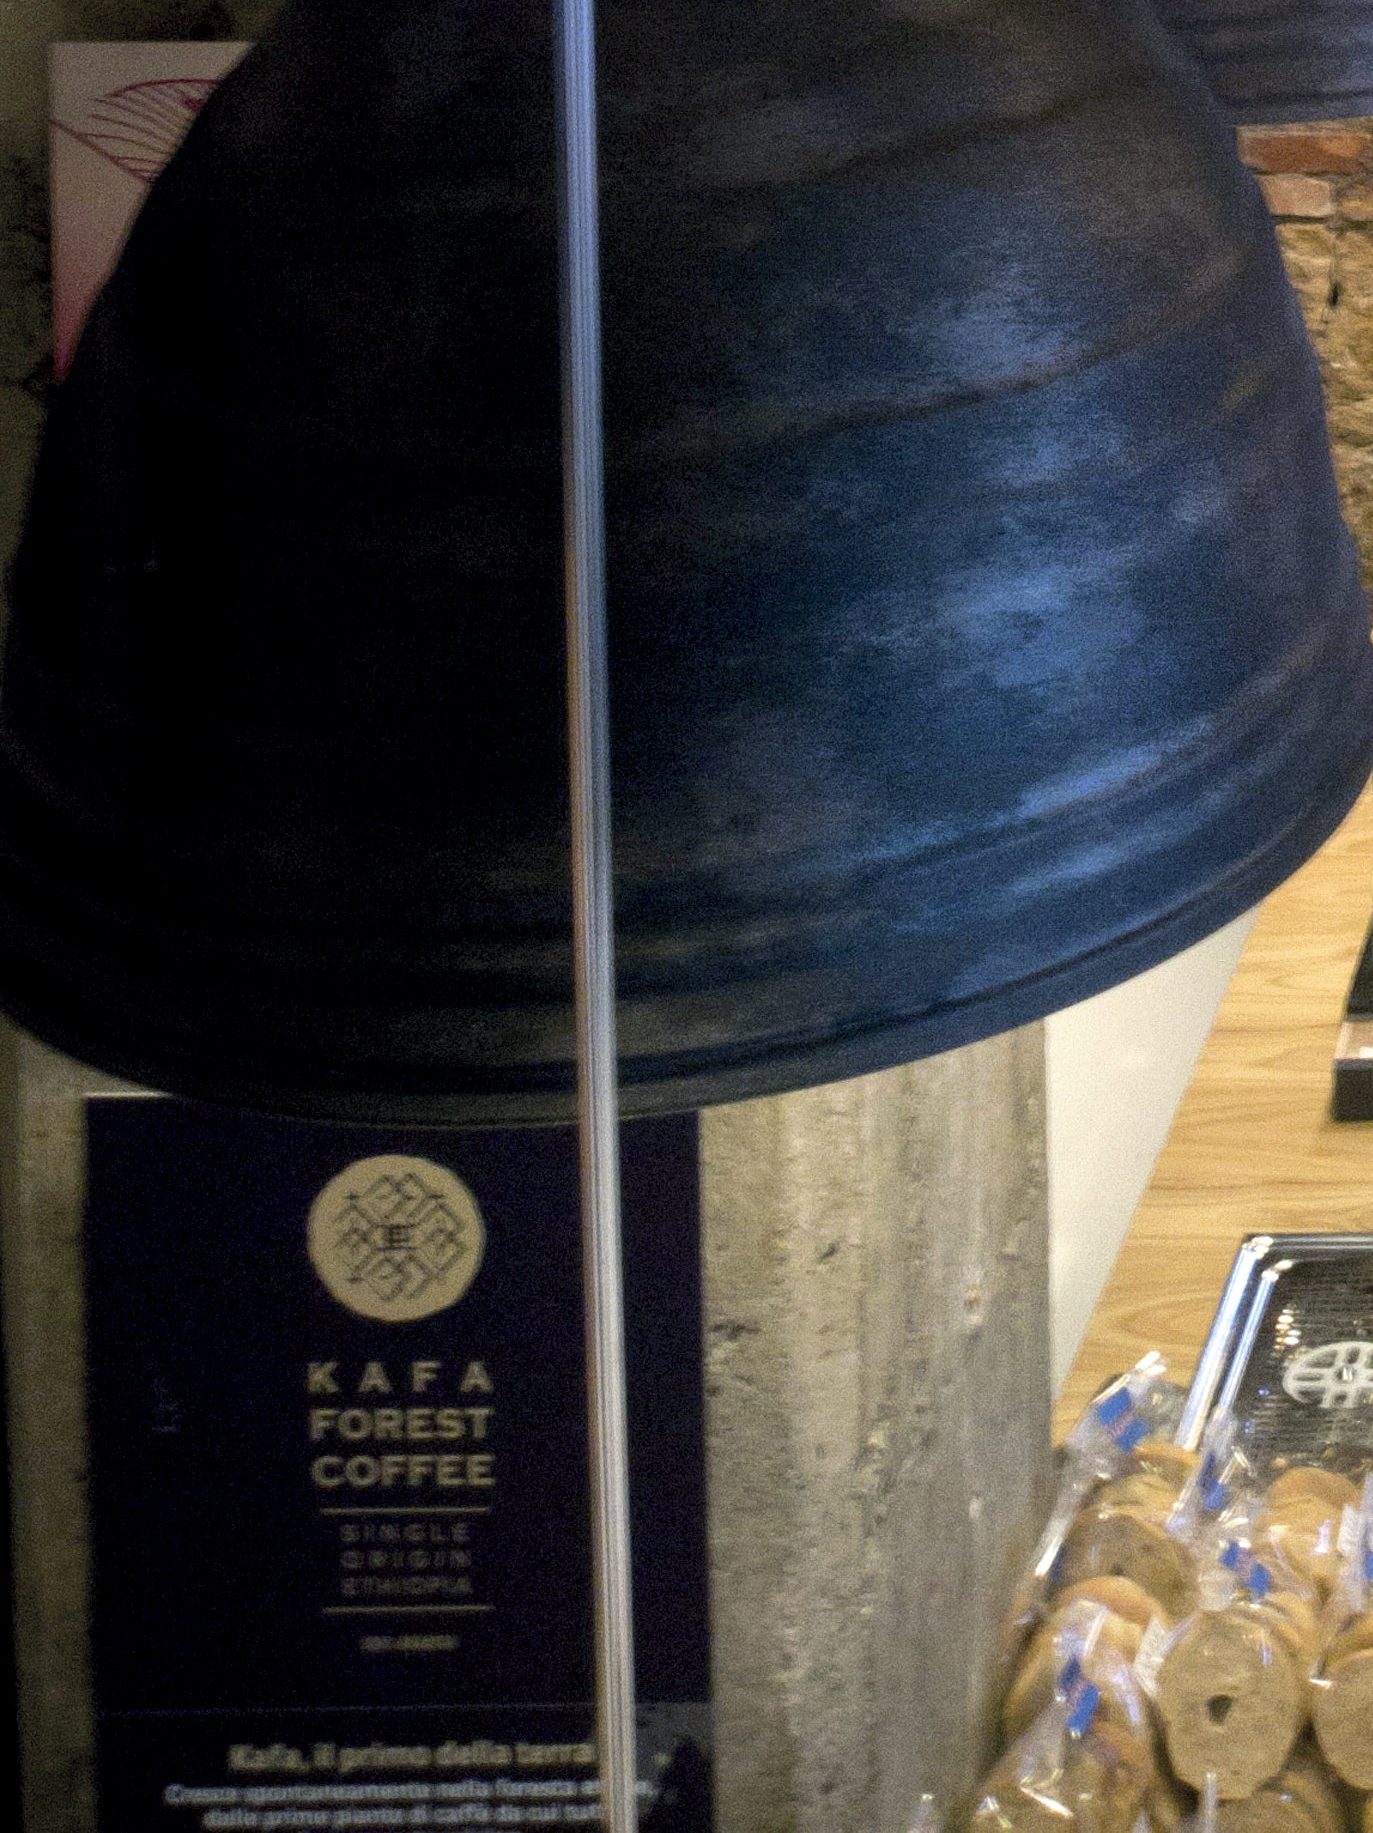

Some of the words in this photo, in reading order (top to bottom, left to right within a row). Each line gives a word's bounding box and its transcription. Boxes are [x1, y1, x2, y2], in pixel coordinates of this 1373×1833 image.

[306, 1360, 495, 1395] KAFA
[309, 1406, 495, 1441] FOREST
[310, 1454, 497, 1488] COFFEE
